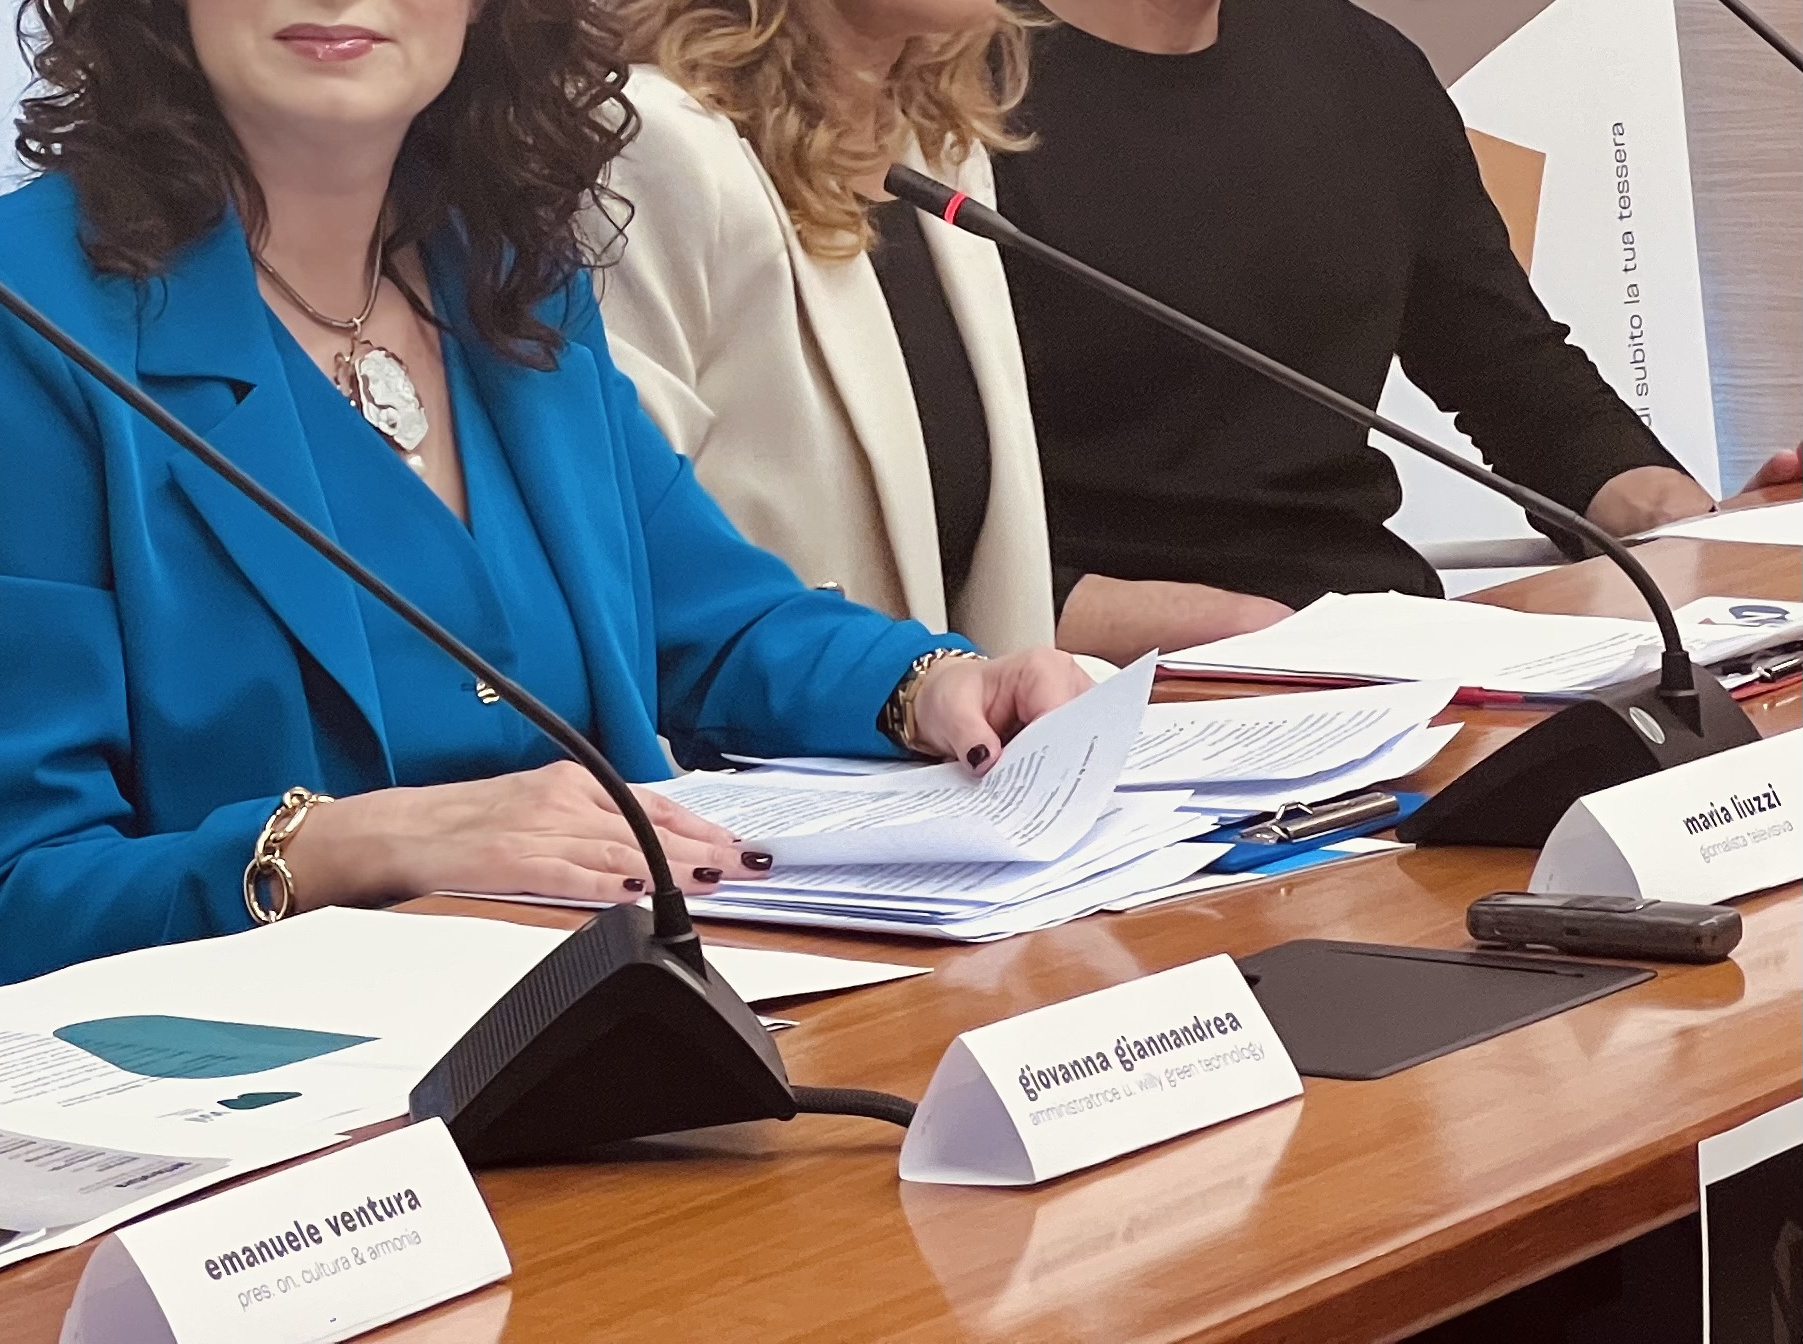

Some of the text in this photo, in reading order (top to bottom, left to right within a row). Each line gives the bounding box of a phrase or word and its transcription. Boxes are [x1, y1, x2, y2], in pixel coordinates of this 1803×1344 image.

[1611, 122, 1633, 222] tessera
[1621, 230, 1638, 274] tua
[1623, 283, 1641, 305] la
[1627, 314, 1649, 397] subito
[1682, 782, 1782, 836] maria liuzzi
[1018, 1011, 1243, 1102] giovanna giannandrea
[1164, 1062, 1198, 1088] green
[1197, 1040, 1266, 1072] technology
[204, 1188, 422, 1281] emanuele ventura
[237, 1227, 422, 1312] pres. on. cultura & armonia
